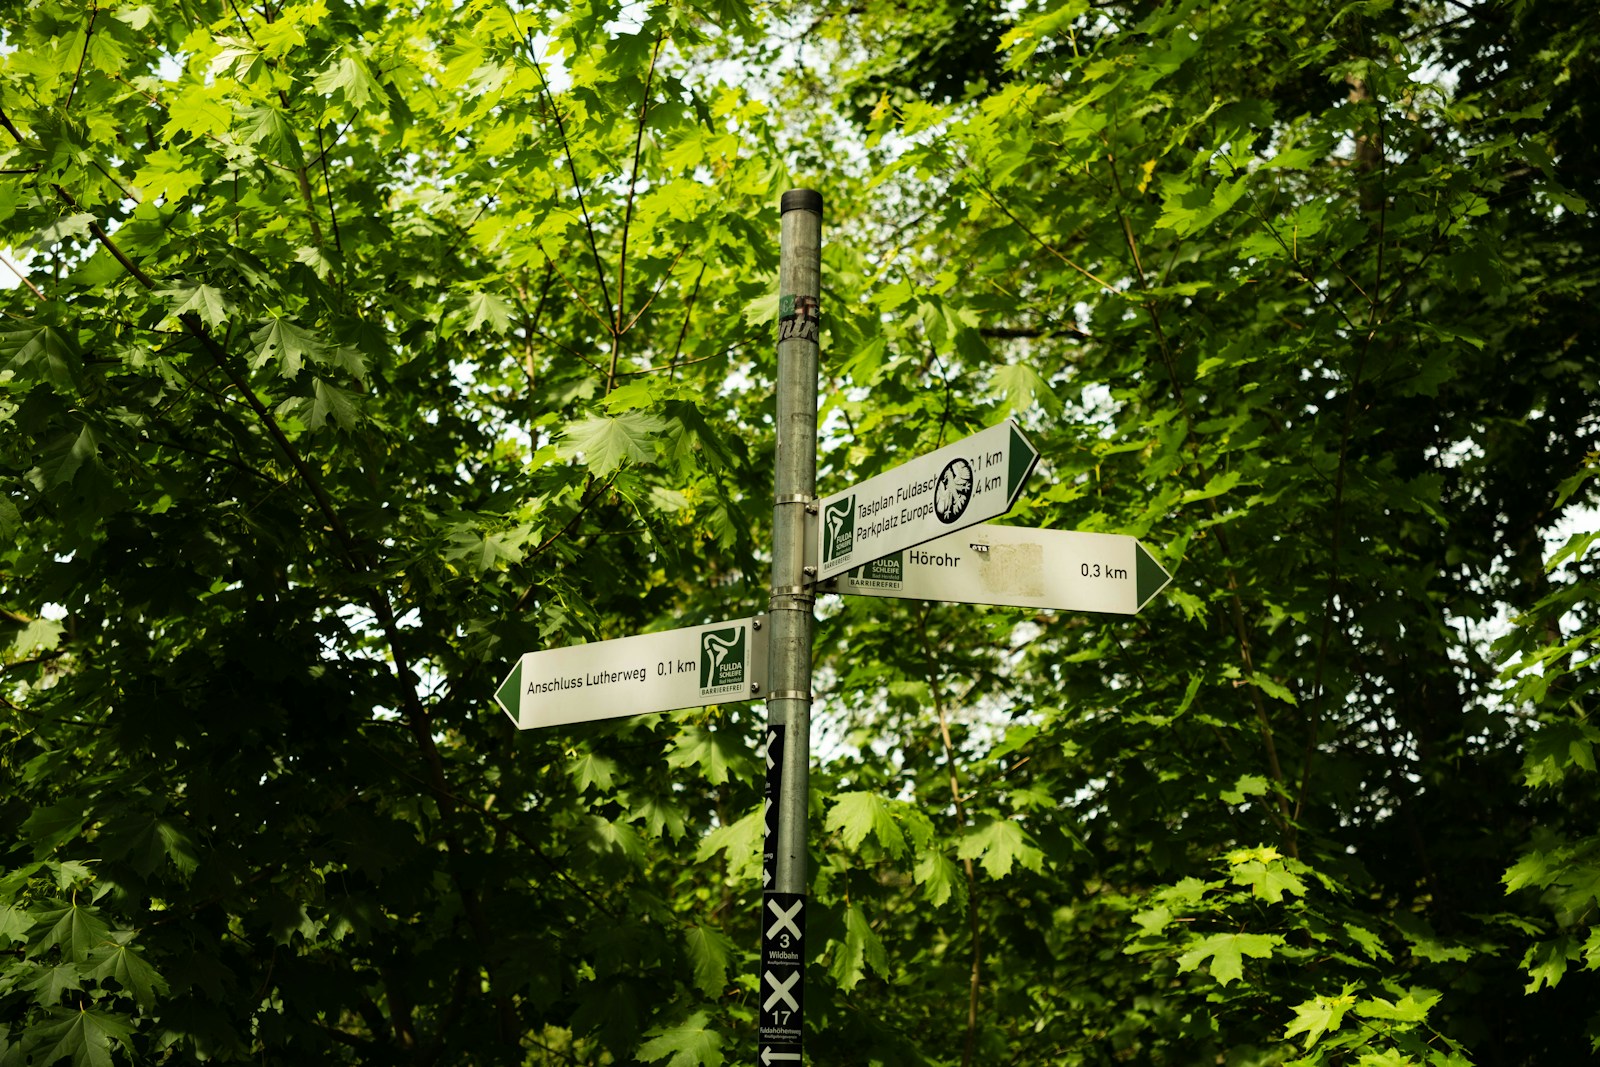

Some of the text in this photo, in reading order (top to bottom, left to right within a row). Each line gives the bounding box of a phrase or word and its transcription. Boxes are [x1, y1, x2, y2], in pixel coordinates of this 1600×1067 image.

[858, 495, 894, 519] Tastplan
[986, 451, 1003, 468] km
[856, 515, 899, 542] Parkplatz
[985, 475, 1002, 492] km
[872, 566, 900, 575] SCHLEIFE
[909, 550, 961, 567] Hörohr
[1105, 564, 1128, 580] km
[850, 579, 900, 589] BARRIEREFREI
[719, 661, 743, 672] FULDA
[527, 676, 583, 695] Anschluss
[586, 668, 647, 687] Lutherweg
[677, 659, 696, 674] km
[719, 669, 742, 679] SCHLEIFE
[701, 684, 742, 696] BARRIEREFREI
[779, 933, 790, 949] 3
[769, 950, 799, 960] Wildbahn
[772, 1010, 792, 1026] 17
